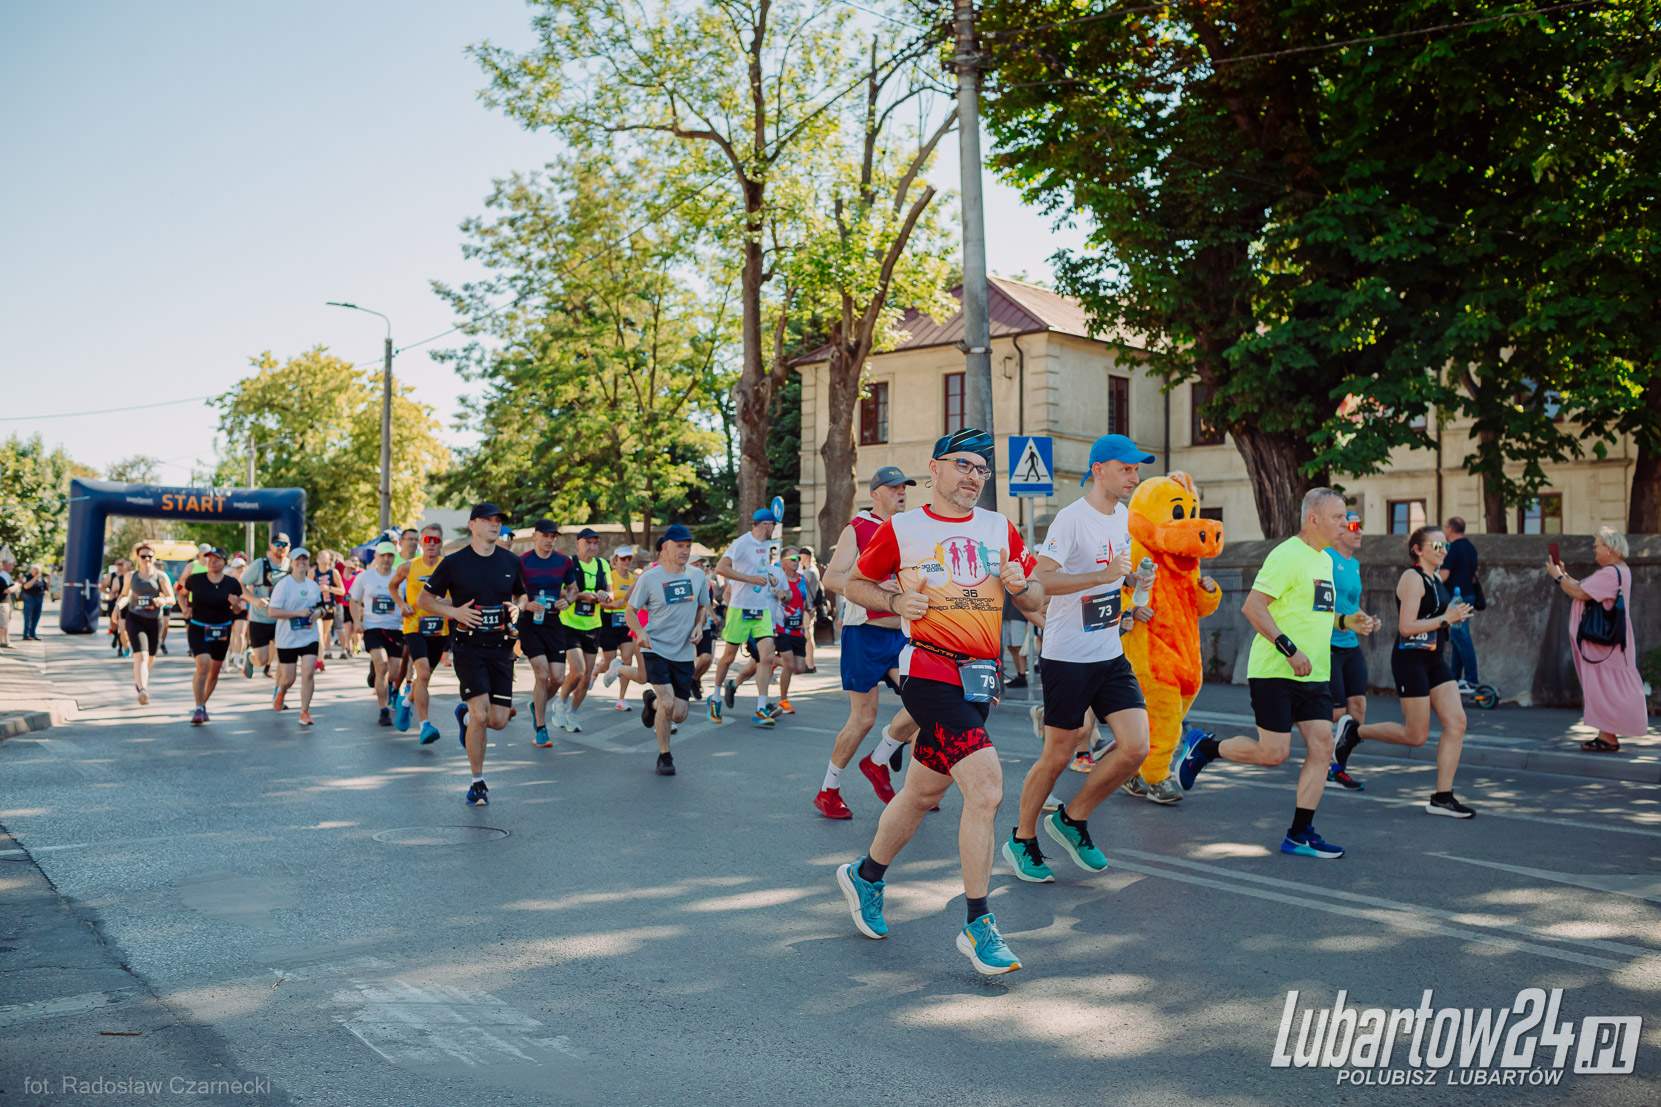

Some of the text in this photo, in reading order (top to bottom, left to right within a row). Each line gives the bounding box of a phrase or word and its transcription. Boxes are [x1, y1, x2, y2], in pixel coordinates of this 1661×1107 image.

[161, 493, 226, 513] START
[674, 586, 686, 596] 82
[1098, 604, 1112, 618] 73
[980, 675, 996, 689] 79
